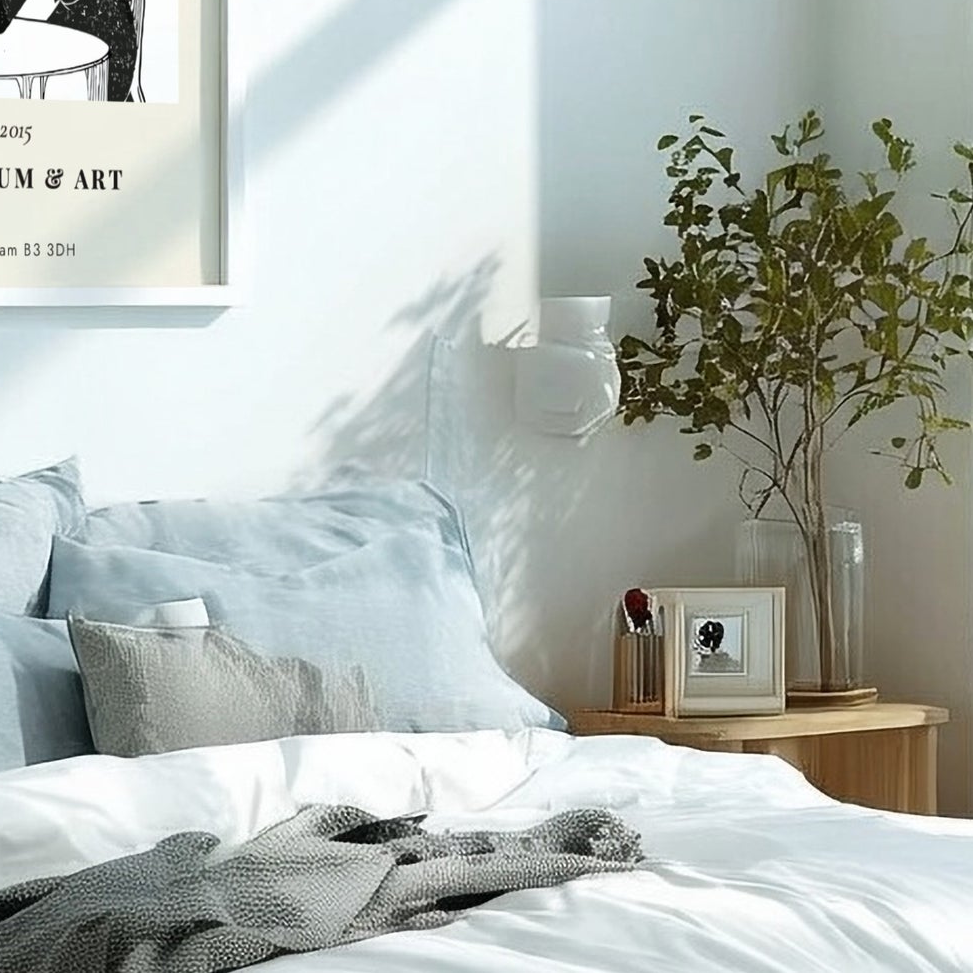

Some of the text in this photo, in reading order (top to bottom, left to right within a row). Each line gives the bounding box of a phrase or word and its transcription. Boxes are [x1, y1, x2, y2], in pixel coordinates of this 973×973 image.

[0, 125, 33, 145] 2015
[44, 168, 64, 190] &
[74, 168, 124, 191] ART
[24, 242, 41, 257] B3
[47, 242, 76, 257] 3DH
